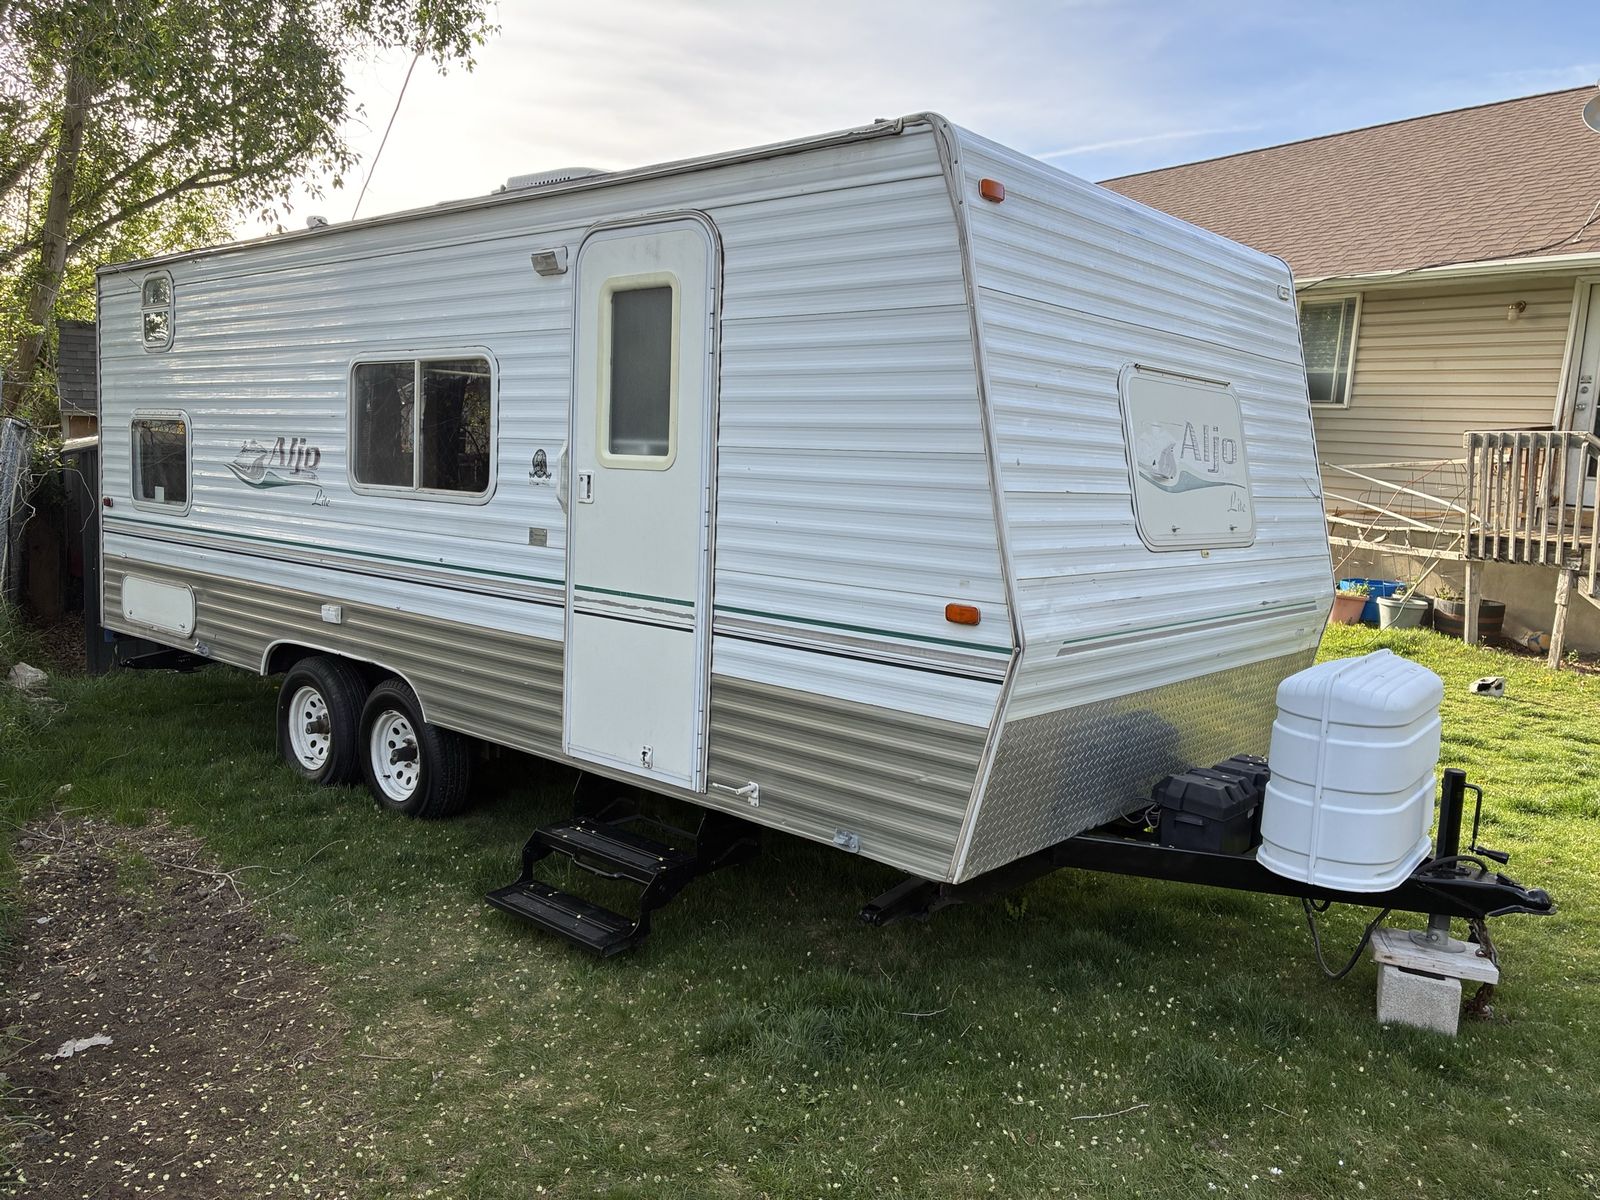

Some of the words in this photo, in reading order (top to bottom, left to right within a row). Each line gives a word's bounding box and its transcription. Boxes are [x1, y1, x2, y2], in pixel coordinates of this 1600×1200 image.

[268, 437, 321, 475] Aljo
[1180, 422, 1237, 473] Aljo
[311, 488, 331, 507] Lite
